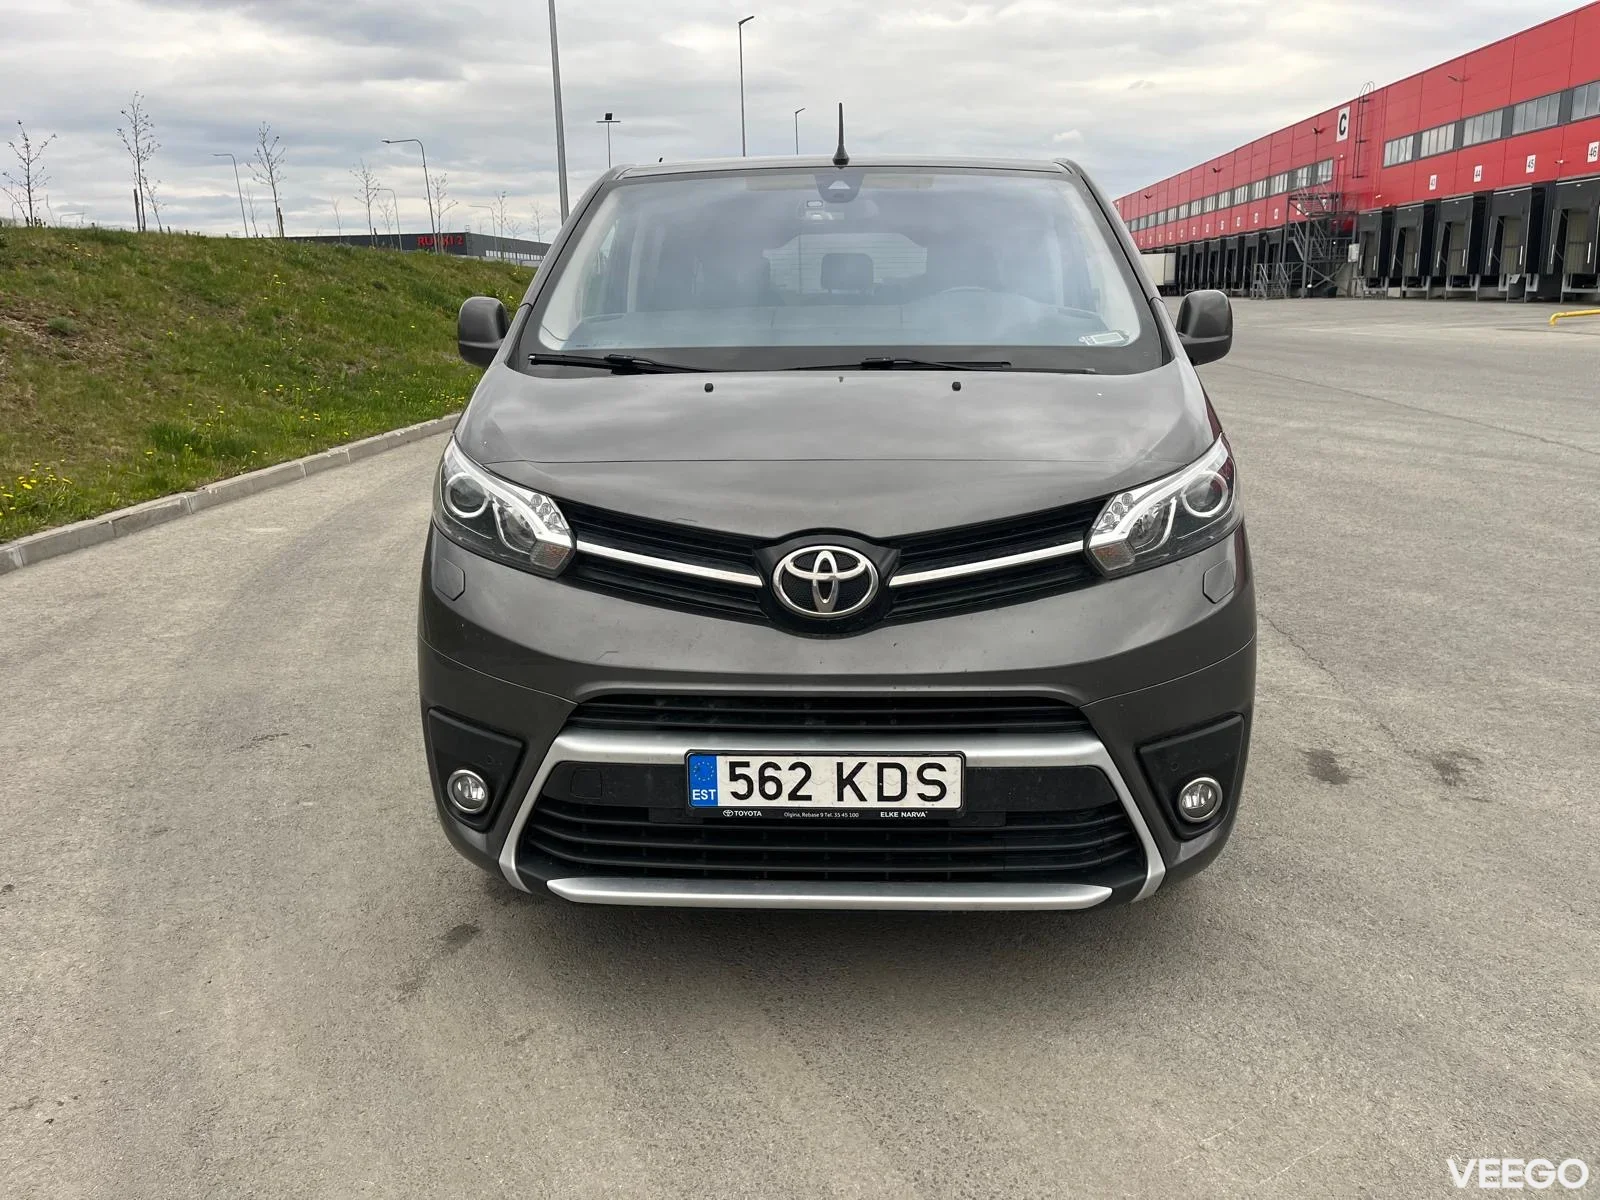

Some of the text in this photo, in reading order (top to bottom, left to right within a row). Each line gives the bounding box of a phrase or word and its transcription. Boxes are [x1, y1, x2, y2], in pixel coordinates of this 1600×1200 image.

[1339, 113, 1347, 136] C
[1589, 146, 1598, 158] 46
[729, 761, 947, 802] 562 KDS
[692, 789, 716, 801] EST
